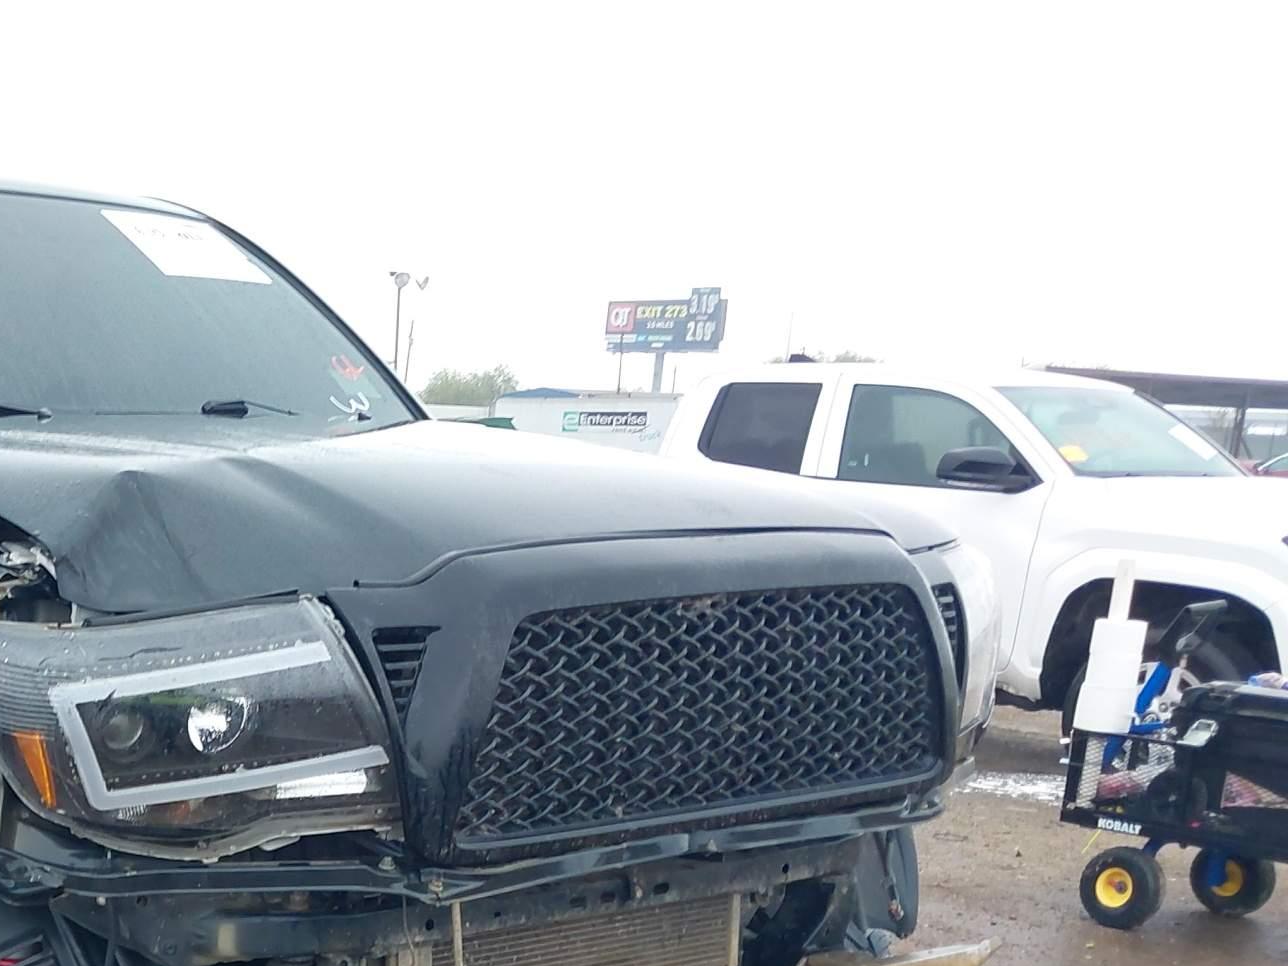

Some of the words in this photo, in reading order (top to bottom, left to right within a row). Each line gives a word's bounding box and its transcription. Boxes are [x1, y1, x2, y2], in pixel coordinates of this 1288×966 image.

[610, 307, 631, 327] QT
[636, 305, 664, 319] EXIT
[664, 304, 688, 318] 273
[579, 412, 647, 427] Enterprise
[1097, 817, 1142, 834] KOBALT
